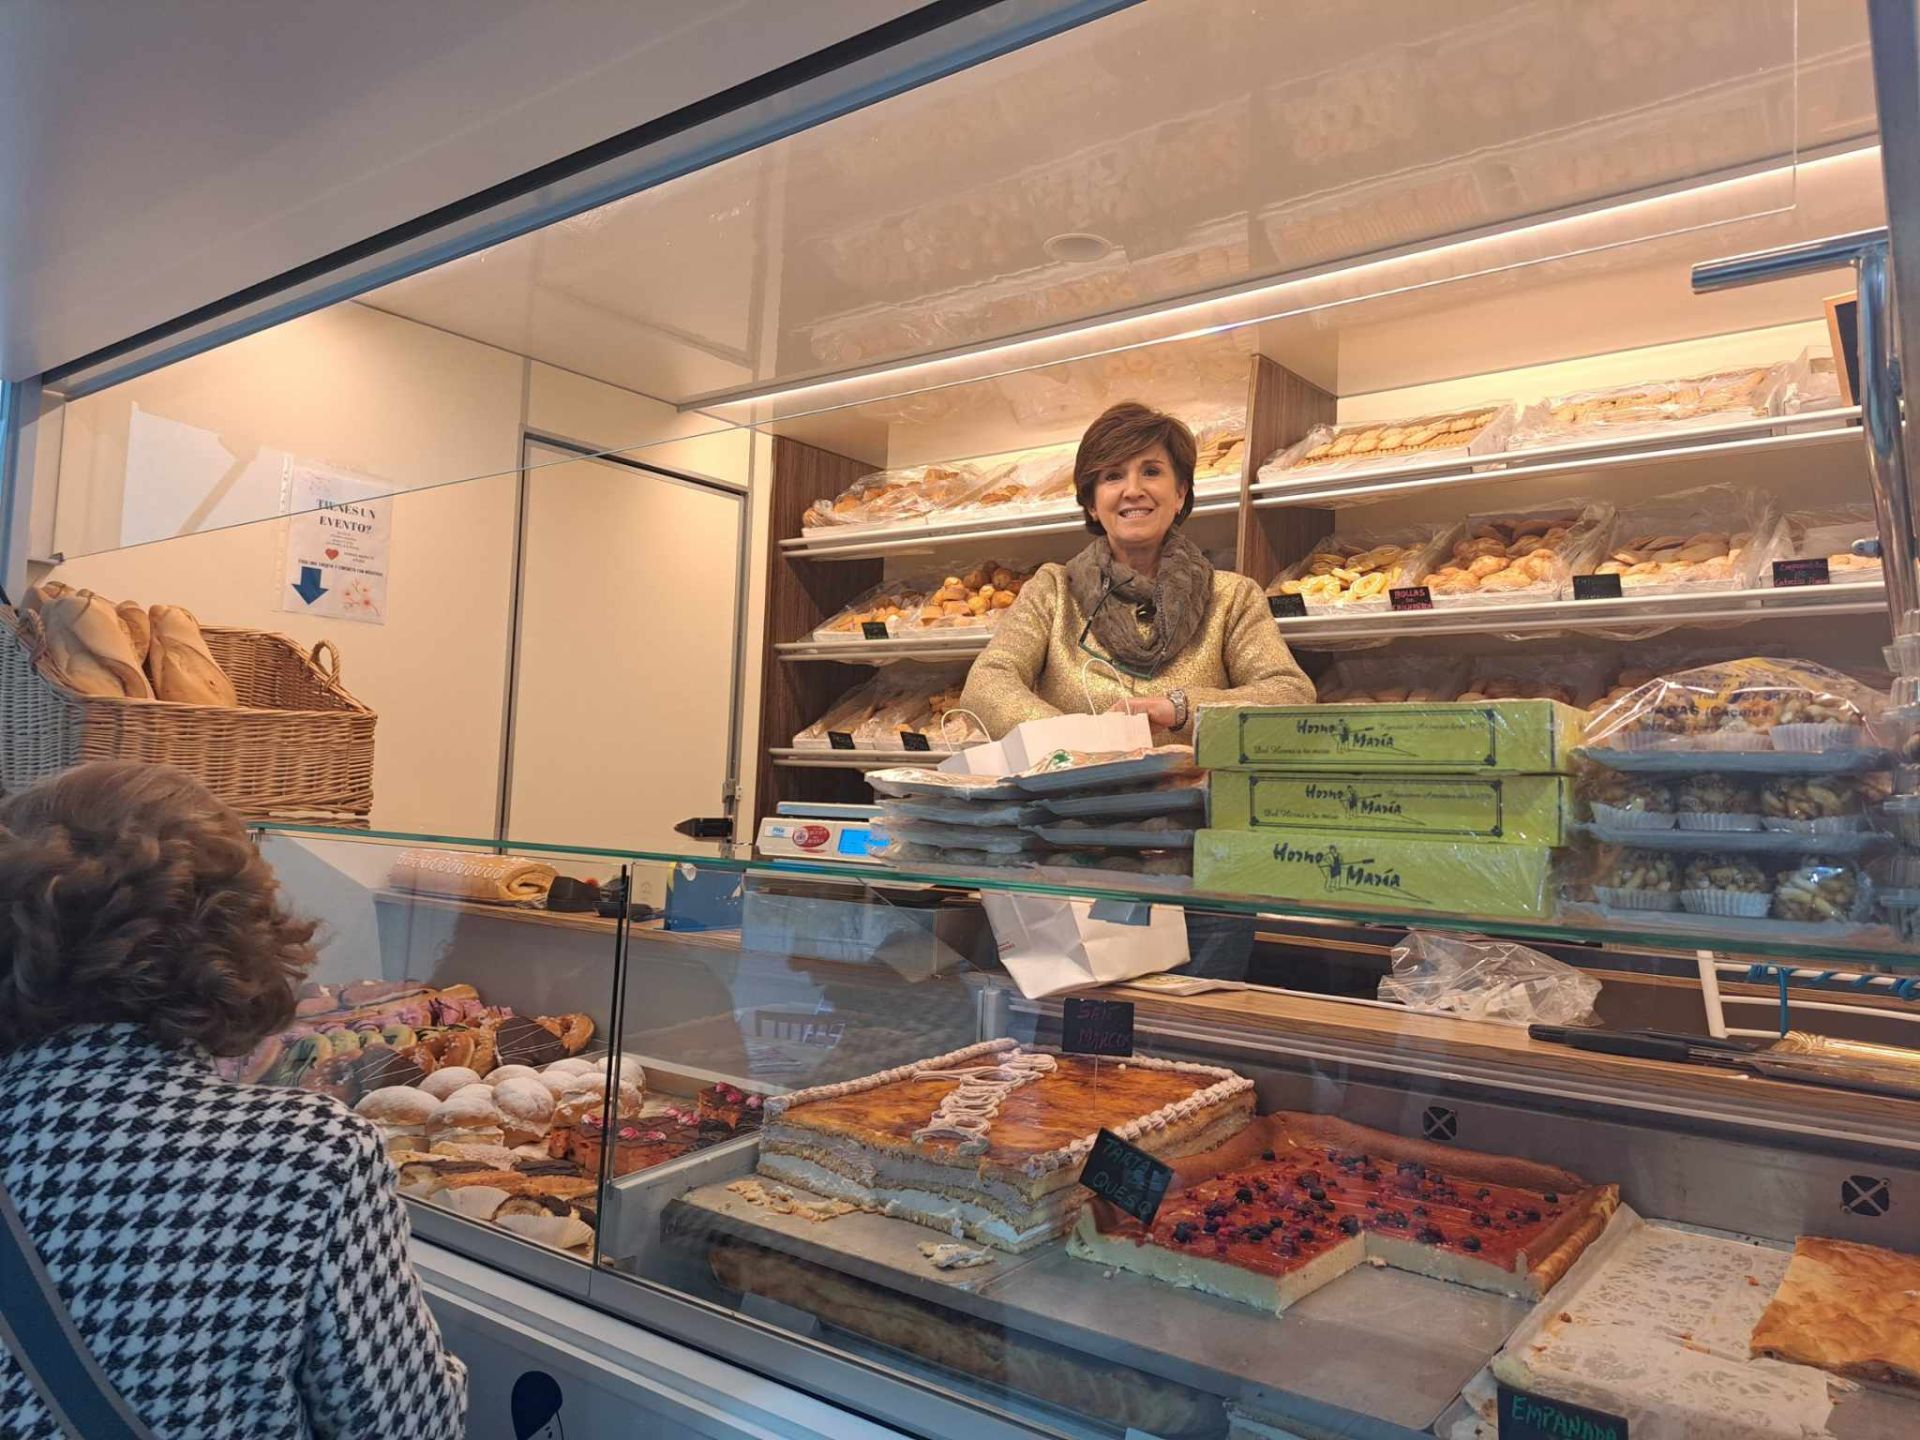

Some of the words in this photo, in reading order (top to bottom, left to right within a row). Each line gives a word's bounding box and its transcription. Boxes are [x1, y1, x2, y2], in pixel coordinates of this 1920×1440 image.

[316, 498, 359, 515] TIENES
[360, 505, 376, 519] UN
[319, 516, 373, 534] EVENTO?
[1296, 719, 1335, 734] Horno
[1353, 733, 1394, 748] María
[1305, 784, 1343, 800] Horno
[1361, 800, 1402, 815] María
[1273, 842, 1324, 864] Horno
[1346, 868, 1400, 887] María
[1102, 1137, 1151, 1171] TARTA
[1093, 1171, 1152, 1214] QUESO
[1511, 1395, 1617, 1440] EMPANADA
